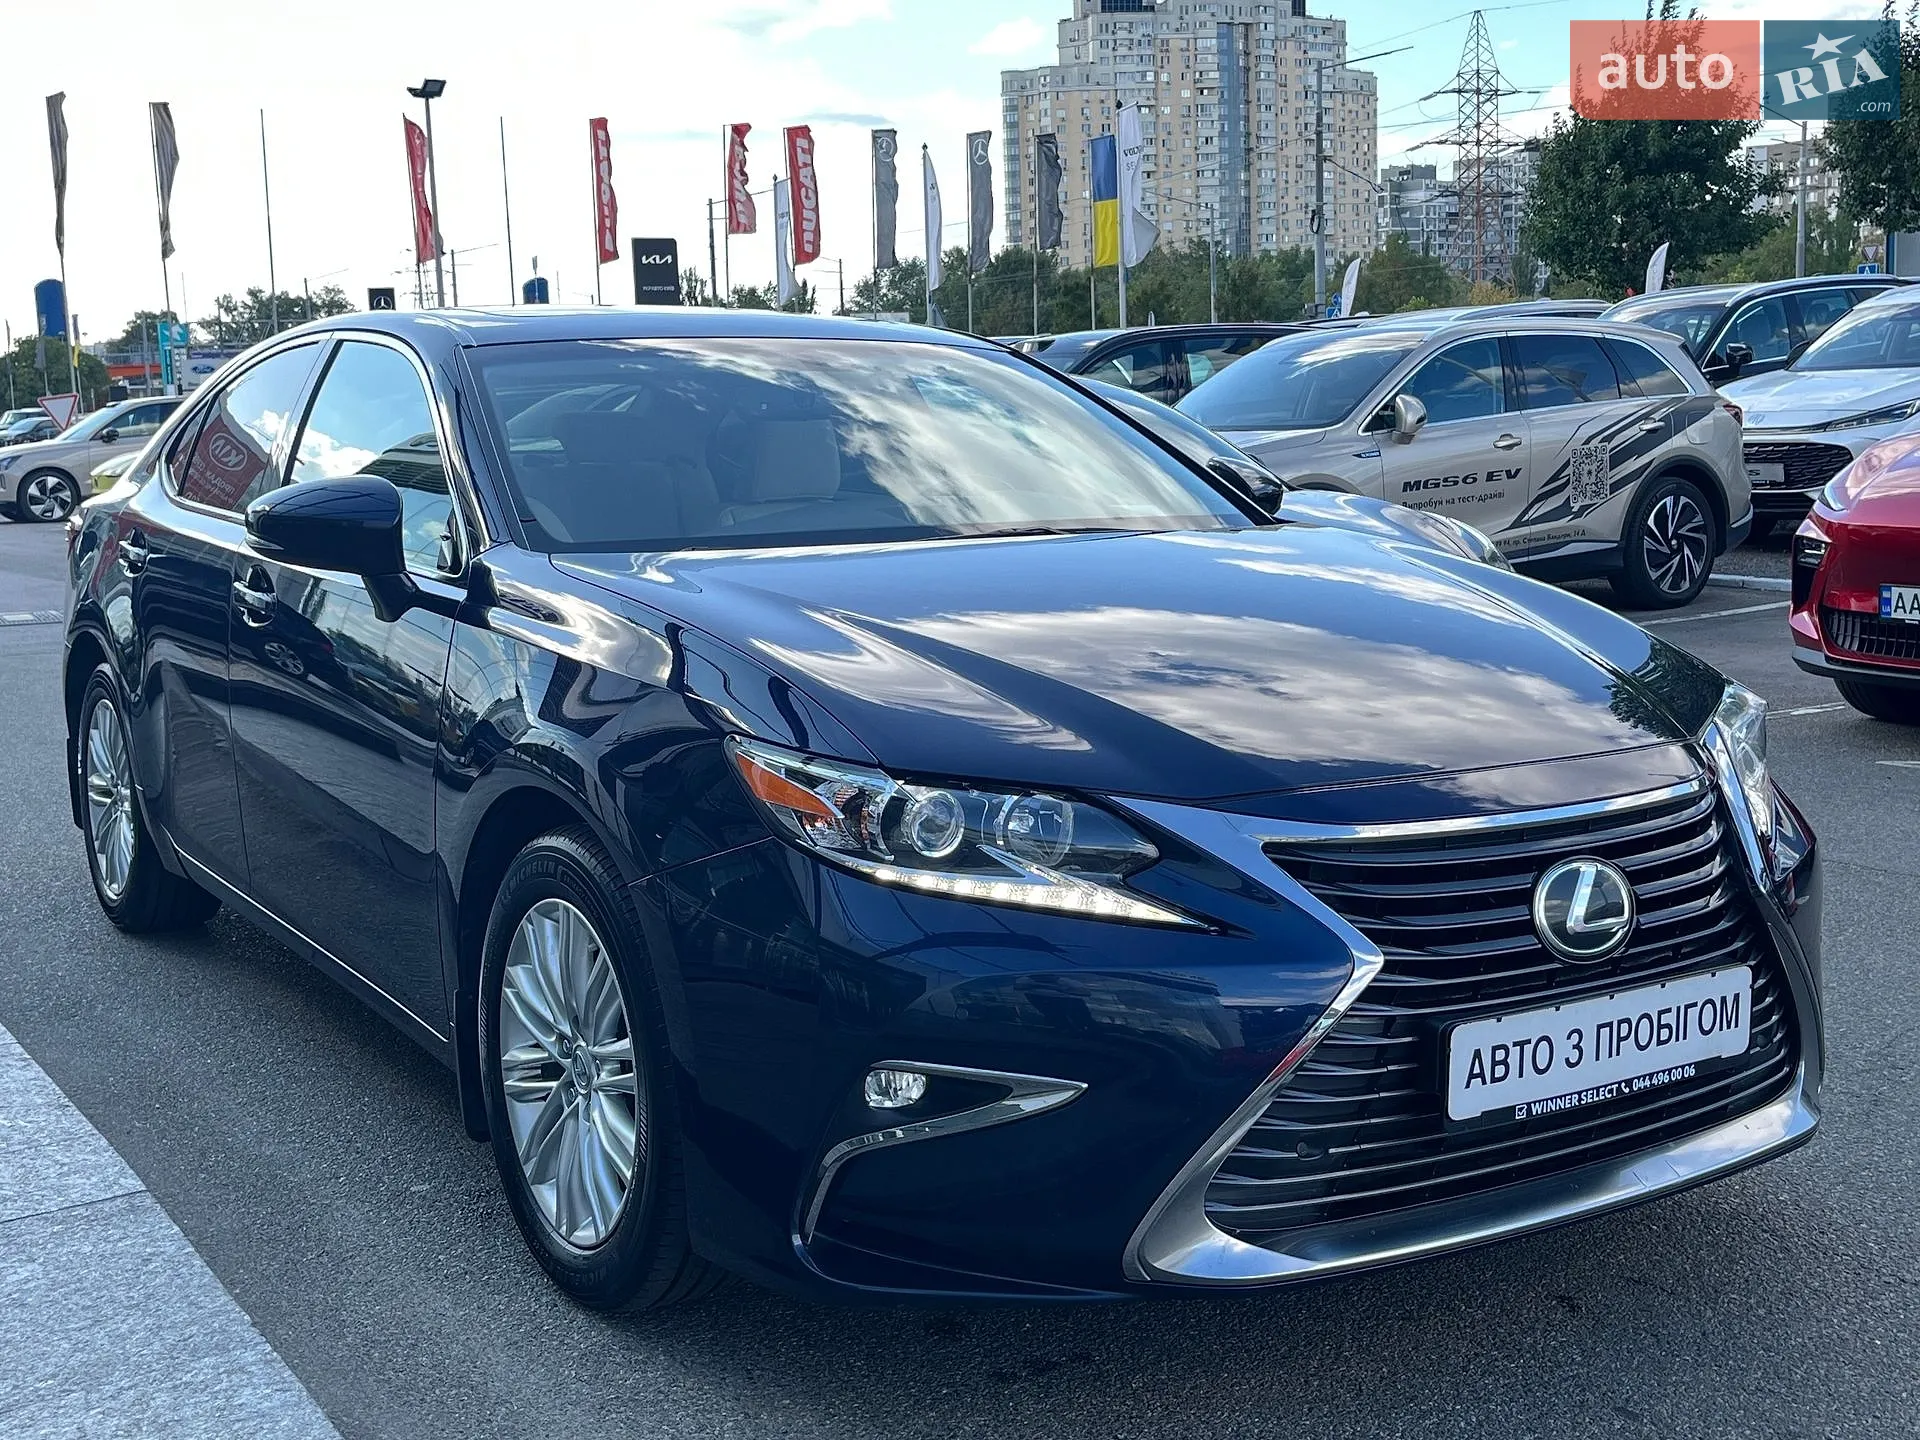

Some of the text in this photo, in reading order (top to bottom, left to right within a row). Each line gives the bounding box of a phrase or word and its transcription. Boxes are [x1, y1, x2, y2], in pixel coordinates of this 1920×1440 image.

[796, 137, 817, 254] DUCATI
[641, 254, 673, 265] KIA
[1402, 467, 1522, 493] MGS6 EV
[1445, 498, 1455, 506] на
[1458, 489, 1505, 504] тест-драйві
[508, 860, 556, 892] MICHELIN
[1464, 1034, 1554, 1090] АВТО
[1595, 992, 1741, 1062] ПРОБІГОМ
[1530, 1064, 1696, 1116] WINNER SELECT 044 496 00 06
